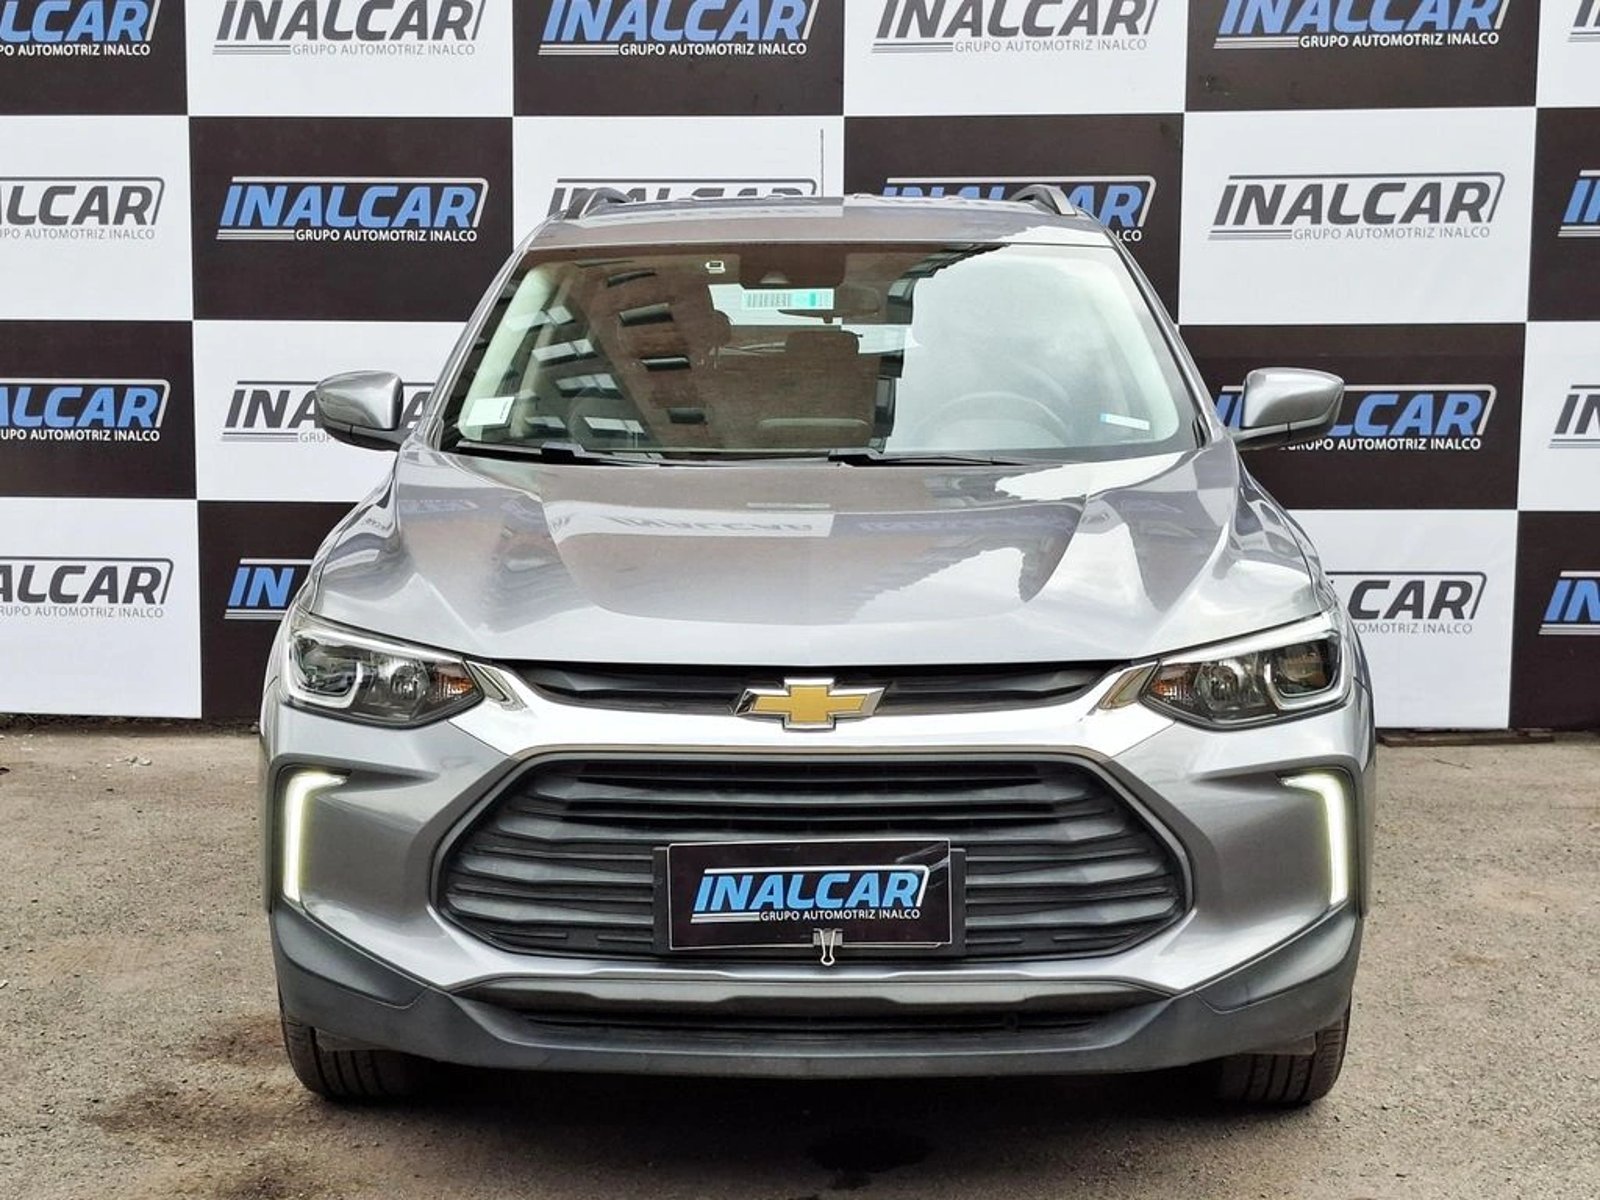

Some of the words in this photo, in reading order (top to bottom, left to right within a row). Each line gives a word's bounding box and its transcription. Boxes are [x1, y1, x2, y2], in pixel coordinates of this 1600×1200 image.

[216, 0, 475, 41] INALCAR
[541, 0, 807, 42] INALCAR
[875, 0, 1147, 38] INALCAR
[1218, 0, 1498, 34] INALCAR
[954, 40, 1000, 53] GRUPO
[1005, 39, 1093, 52] AUTOMOTRIZ
[1097, 38, 1147, 51] INALCO
[1300, 35, 1348, 48] GRUPO
[1352, 34, 1443, 47] AUTOMOTRIZ
[1447, 32, 1499, 46] INALCO
[18, 44, 101, 56] AUTOMOTRIZ
[103, 43, 151, 56] INALCO
[292, 43, 337, 56] GRUPO
[340, 43, 424, 56] AUTOMOTRIZ
[427, 44, 475, 56] INALCO
[619, 43, 665, 56] GRUPO
[669, 43, 755, 56] AUTOMOTRIZ
[758, 42, 807, 55] INALCO
[0, 185, 153, 225] LCAR
[219, 185, 477, 228] INALCAR
[1213, 182, 1491, 226] INALCAR
[25, 228, 105, 240] AUTOMOTRIZ
[109, 228, 155, 240] INALCO
[296, 229, 340, 241] GRUPO
[343, 229, 427, 242] AUTOMOTRIZ
[430, 230, 477, 242] INALCO
[1293, 227, 1341, 240] GRUPO
[1345, 227, 1435, 240] AUTOMOTRIZ
[1439, 225, 1490, 239] INALCO
[0, 386, 158, 428] LCAR
[30, 429, 111, 441] AUTOMOTRIZ
[114, 429, 160, 441] INALCO
[1337, 438, 1425, 450] AUTOMOTRIZ
[1430, 437, 1481, 450] INALCO
[35, 605, 114, 617] AUTOMOTRIZ
[118, 606, 164, 618] INALCO
[1354, 623, 1419, 634] OMOTRIZ
[1423, 622, 1473, 634] INALCO
[693, 872, 921, 912] INALCAR
[760, 910, 800, 922] GRUPO
[803, 909, 876, 921] AUTOMOTRIZ
[879, 908, 921, 920] INALCO
